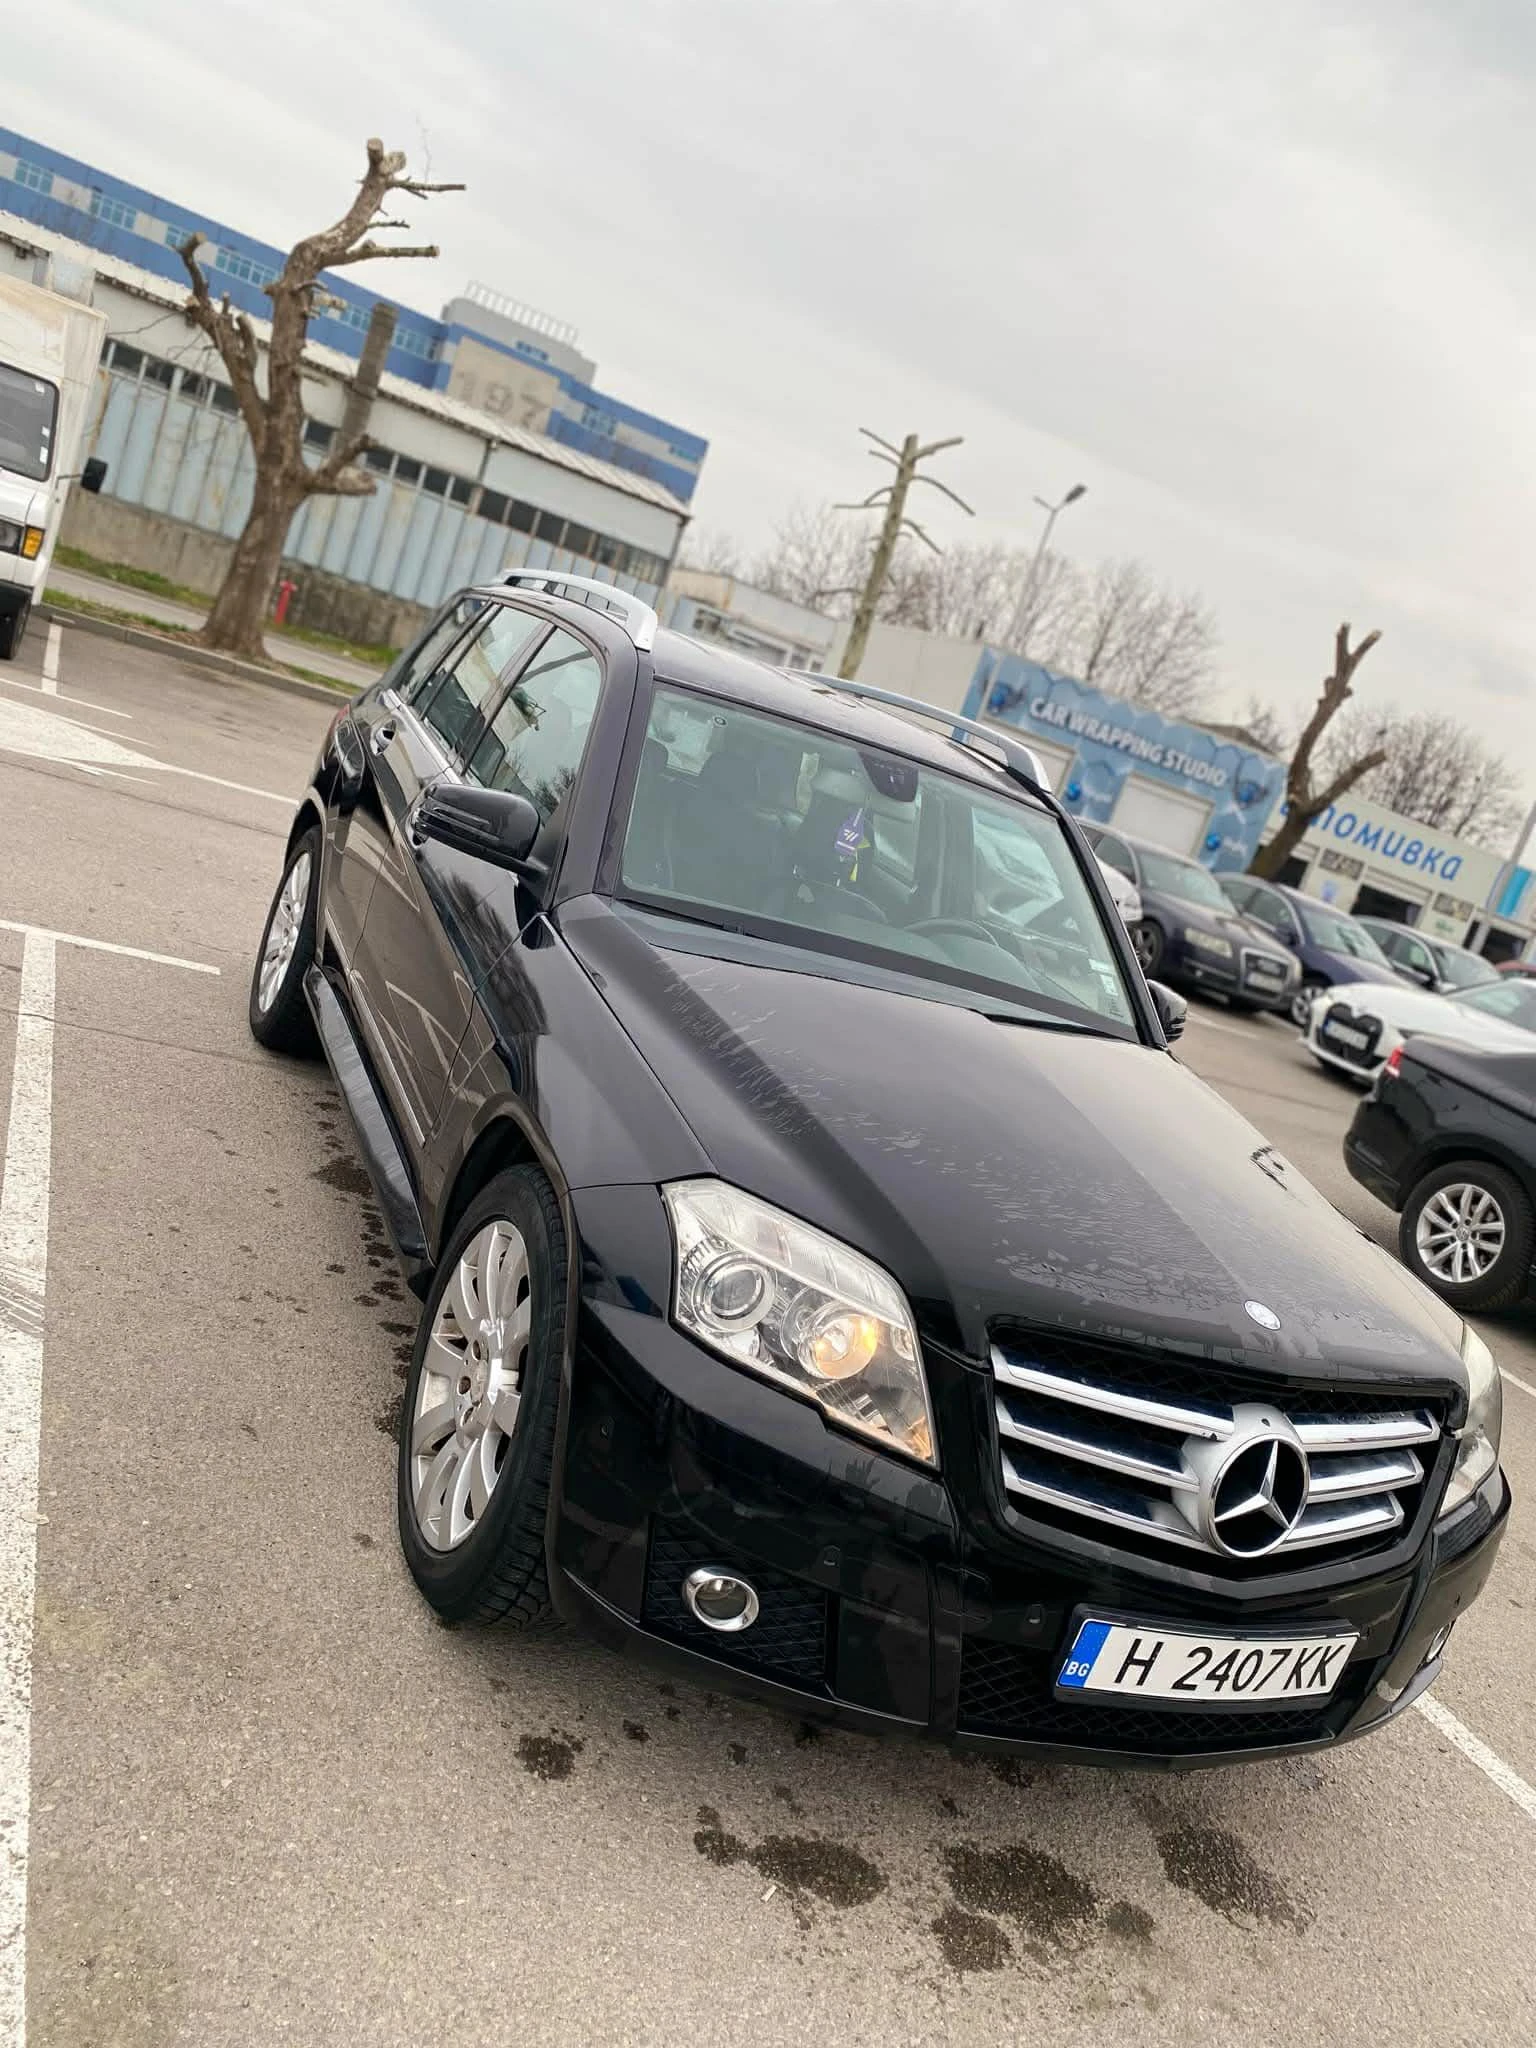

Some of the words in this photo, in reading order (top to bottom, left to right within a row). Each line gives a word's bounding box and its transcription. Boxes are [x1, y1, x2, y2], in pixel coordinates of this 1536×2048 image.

[1029, 698, 1070, 726] CAR
[1069, 710, 1163, 764] WRAPPING
[1163, 748, 1227, 788] STUDIO
[1065, 1661, 1090, 1677] BG
[1114, 1638, 1164, 1686] H
